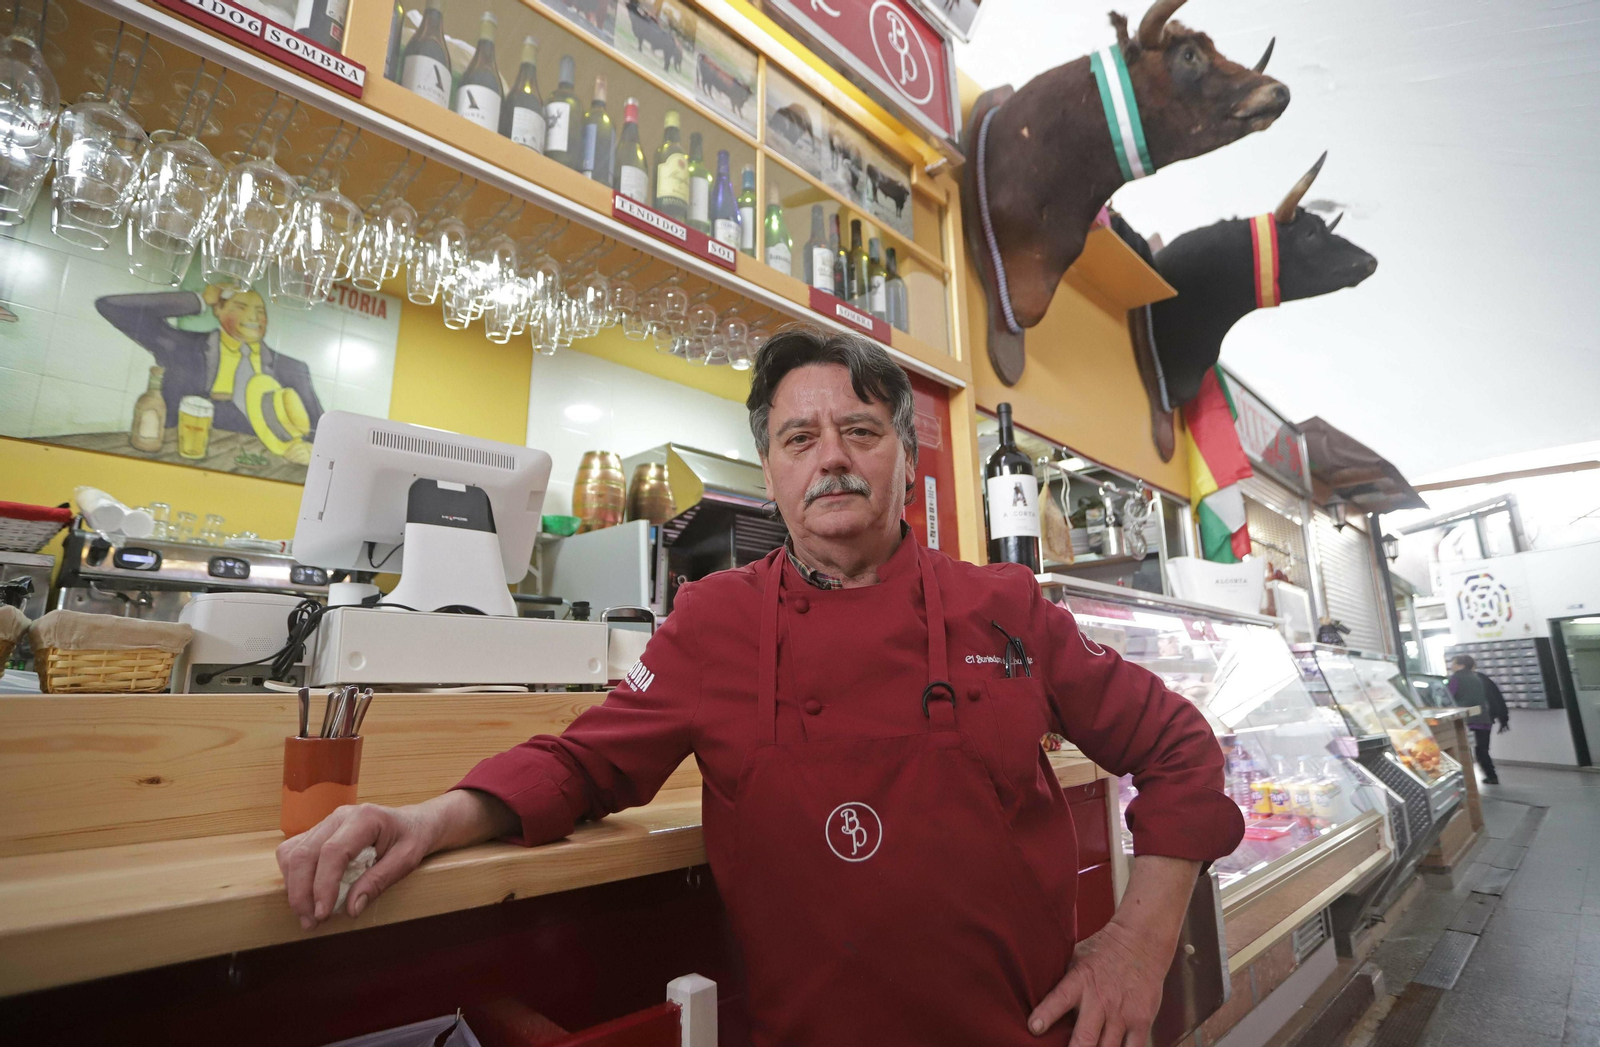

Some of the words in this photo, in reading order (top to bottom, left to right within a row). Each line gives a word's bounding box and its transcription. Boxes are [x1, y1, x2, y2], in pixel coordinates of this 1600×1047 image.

[269, 28, 360, 82] SOMBRA
[619, 198, 686, 238] TENDIDO2
[710, 243, 734, 261] SOL
[838, 306, 873, 329] SOMBRA
[1003, 510, 1036, 518] ACORTA
